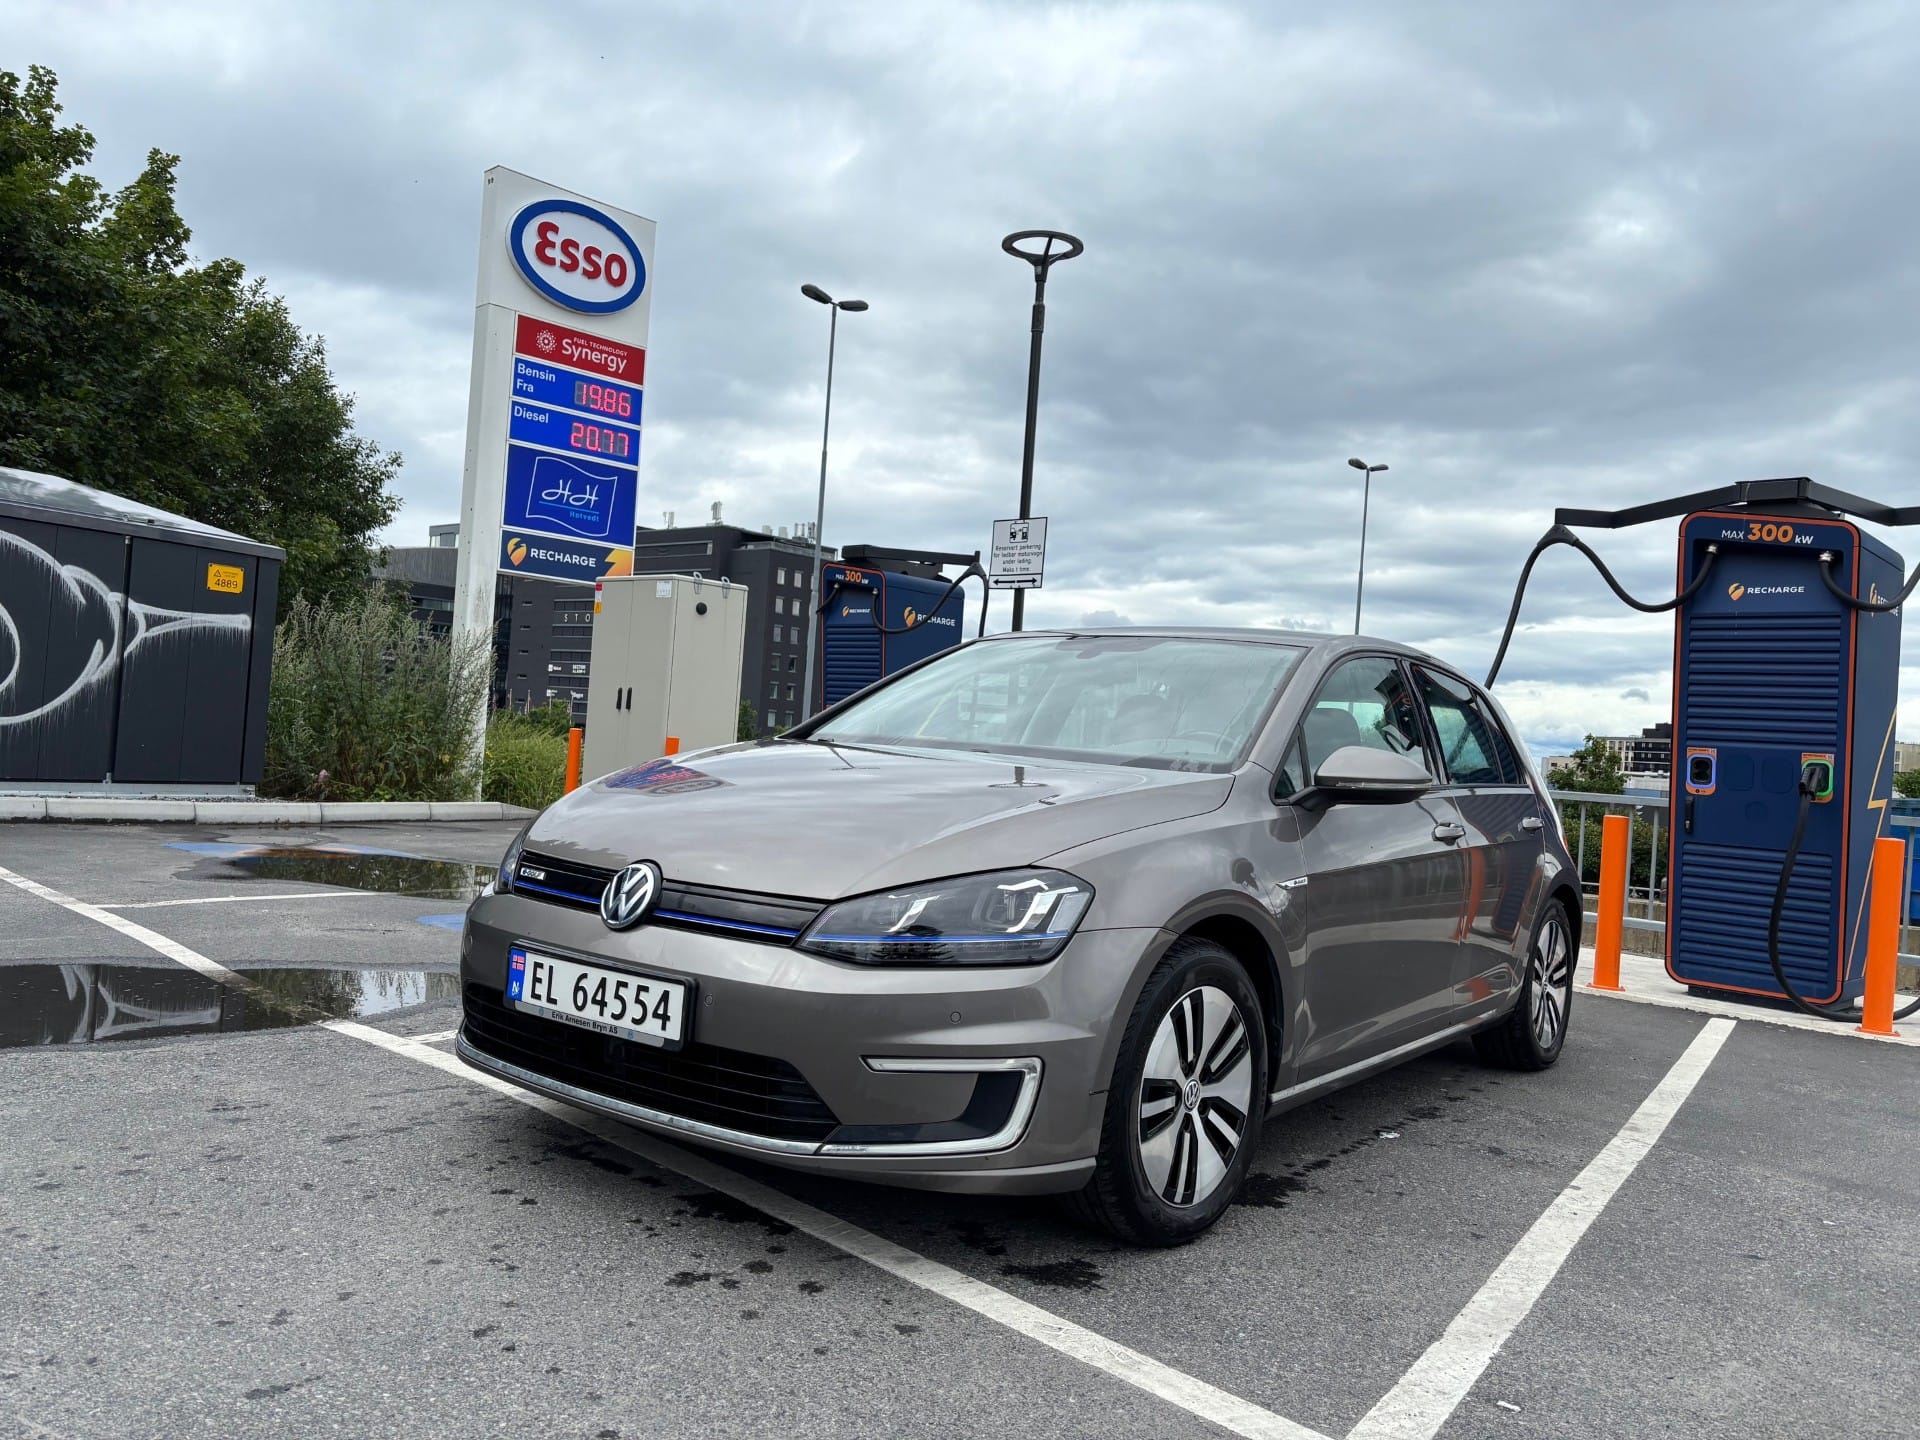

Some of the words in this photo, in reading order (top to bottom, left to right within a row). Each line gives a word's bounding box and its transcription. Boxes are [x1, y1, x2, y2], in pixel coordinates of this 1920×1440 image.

[562, 338, 627, 374] Synergy
[573, 337, 589, 346] FUEL
[590, 341, 628, 357] TECHNOLOGY
[517, 363, 556, 383] Bensin
[516, 379, 534, 392] Fra
[582, 383, 631, 417] 19.86
[514, 405, 549, 424] Diesel
[570, 422, 629, 456] 20.77
[1721, 529, 1745, 540] MAX
[1747, 523, 1793, 543] 300
[1795, 534, 1814, 544] kW
[530, 548, 597, 567] RECHARGE
[214, 578, 238, 589] 4889
[845, 570, 862, 583] 300
[1747, 586, 1805, 594] RECHARGE
[512, 980, 520, 996] N
[531, 961, 557, 1005] EL
[573, 972, 670, 1031] 64554
[551, 1011, 564, 1022] Erik
[565, 1014, 590, 1028] Arnesen
[592, 1021, 608, 1033] Bryn
[609, 1025, 618, 1034] AS
